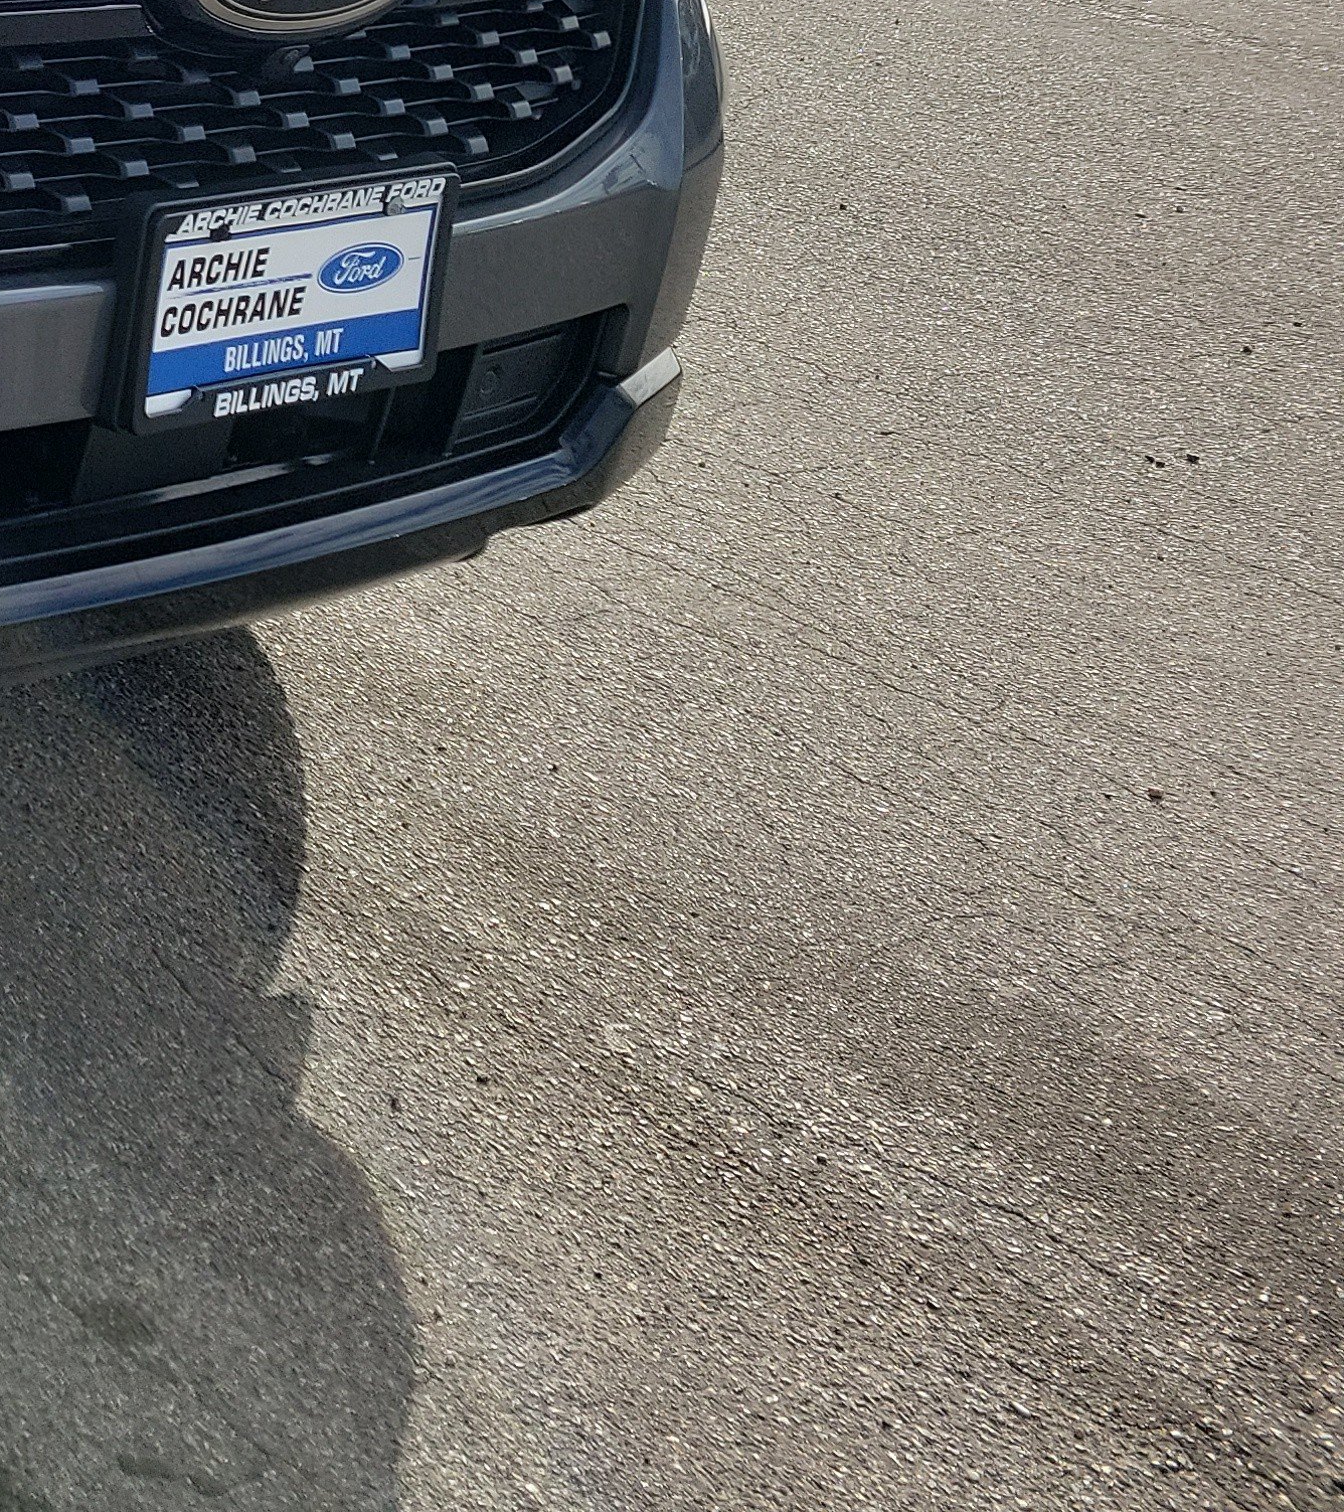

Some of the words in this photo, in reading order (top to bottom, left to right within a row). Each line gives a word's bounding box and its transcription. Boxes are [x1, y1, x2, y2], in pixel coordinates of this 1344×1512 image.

[176, 203, 263, 237] ARCHIE
[263, 186, 386, 221] COCHRANE
[386, 177, 447, 204] FORD
[166, 246, 270, 292] ARCHIE
[333, 250, 387, 286] Ford
[160, 285, 308, 338] COCHRANE
[223, 334, 310, 374] BILLINGS,
[314, 327, 344, 357] MT
[213, 376, 319, 418] BILLINGS,
[326, 368, 365, 396] MT
